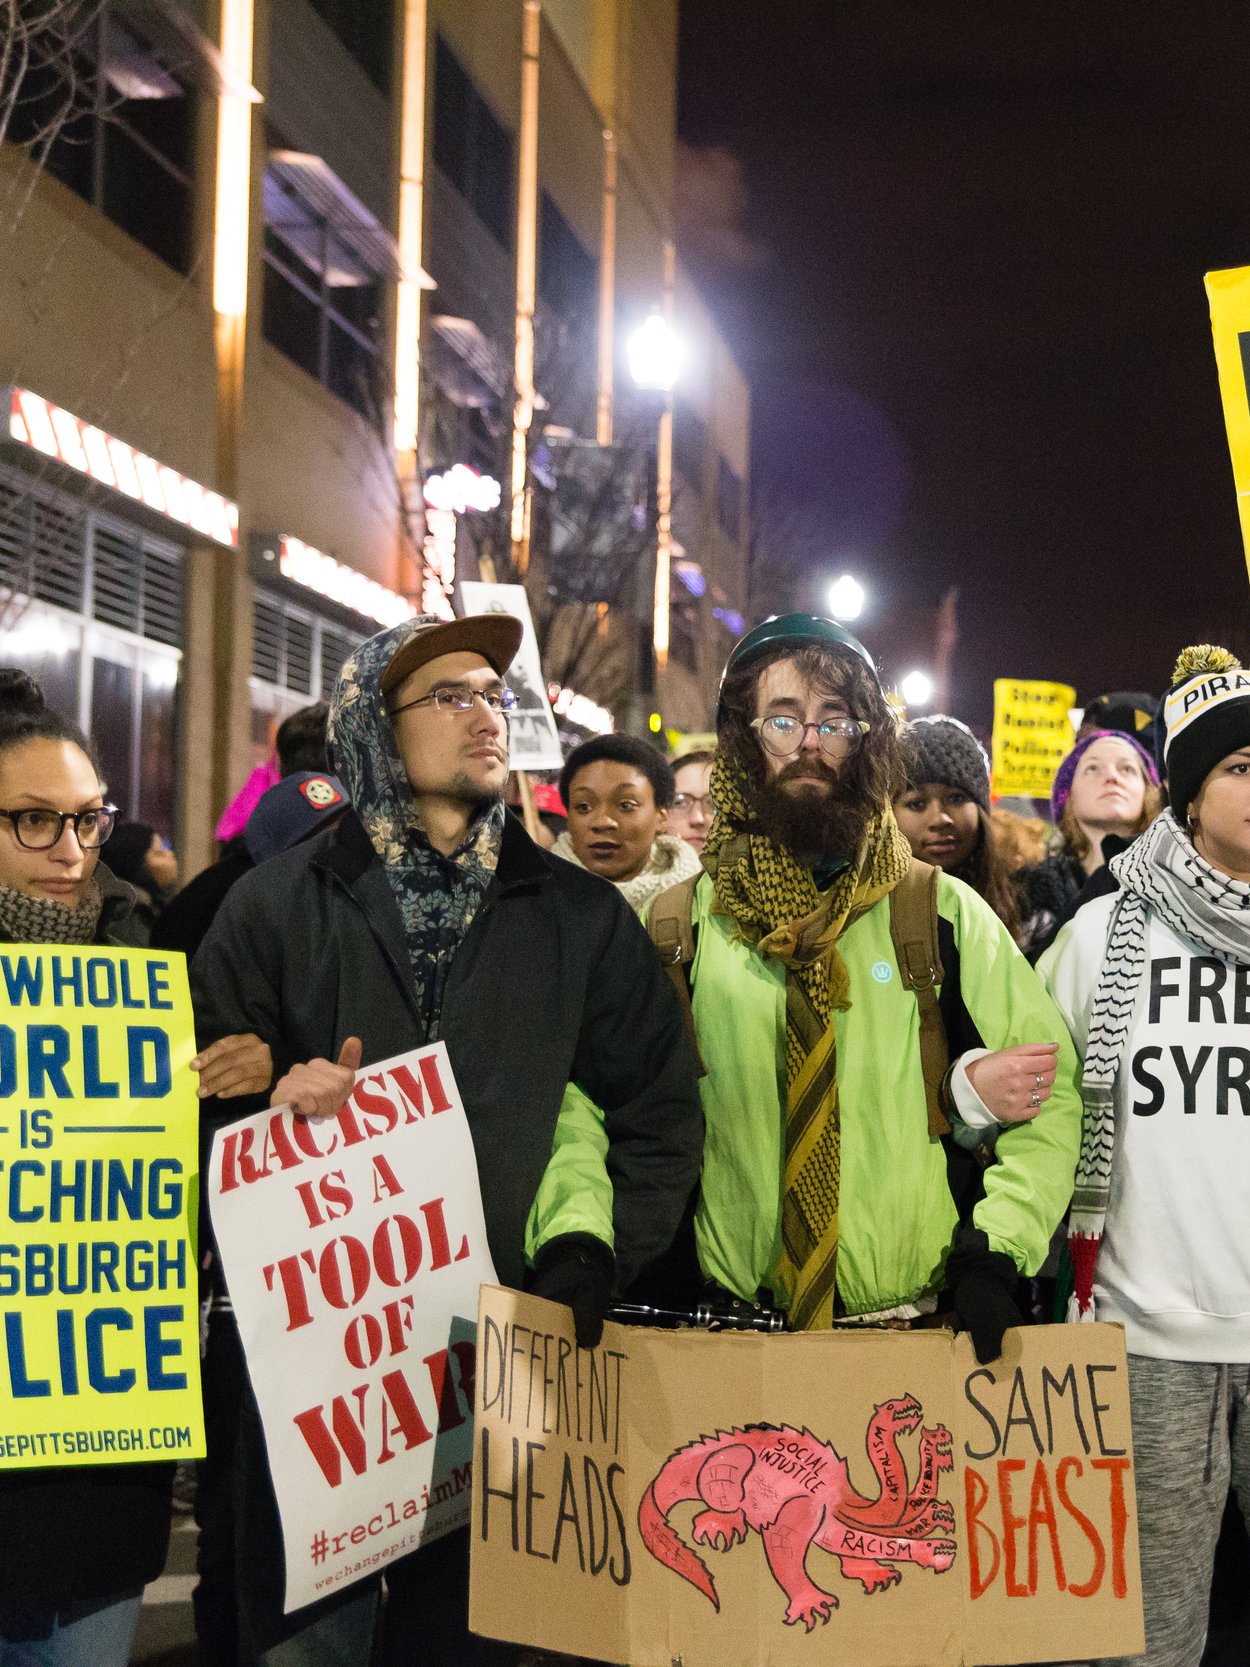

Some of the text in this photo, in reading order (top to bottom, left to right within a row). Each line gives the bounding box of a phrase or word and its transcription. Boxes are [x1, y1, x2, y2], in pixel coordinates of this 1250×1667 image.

[0, 955, 174, 1011] WHOLE
[20, 1109, 53, 1149] IS
[219, 1053, 453, 1195] RACISM
[0, 1158, 184, 1224] CHING
[294, 1153, 405, 1229] IS A
[0, 1239, 187, 1297] SBURGH
[262, 1196, 471, 1332] TOOL
[4, 1304, 188, 1398] LICE
[343, 1295, 415, 1370] OF
[483, 1314, 629, 1454] DIFFERENT
[964, 1363, 1127, 1459] SAME
[758, 1447, 826, 1495] INJUSTICE
[774, 1437, 828, 1477] SOCIAL
[481, 1427, 632, 1586] HEADS
[964, 1457, 1131, 1601] BEAST
[841, 1530, 913, 1559] RACISM
